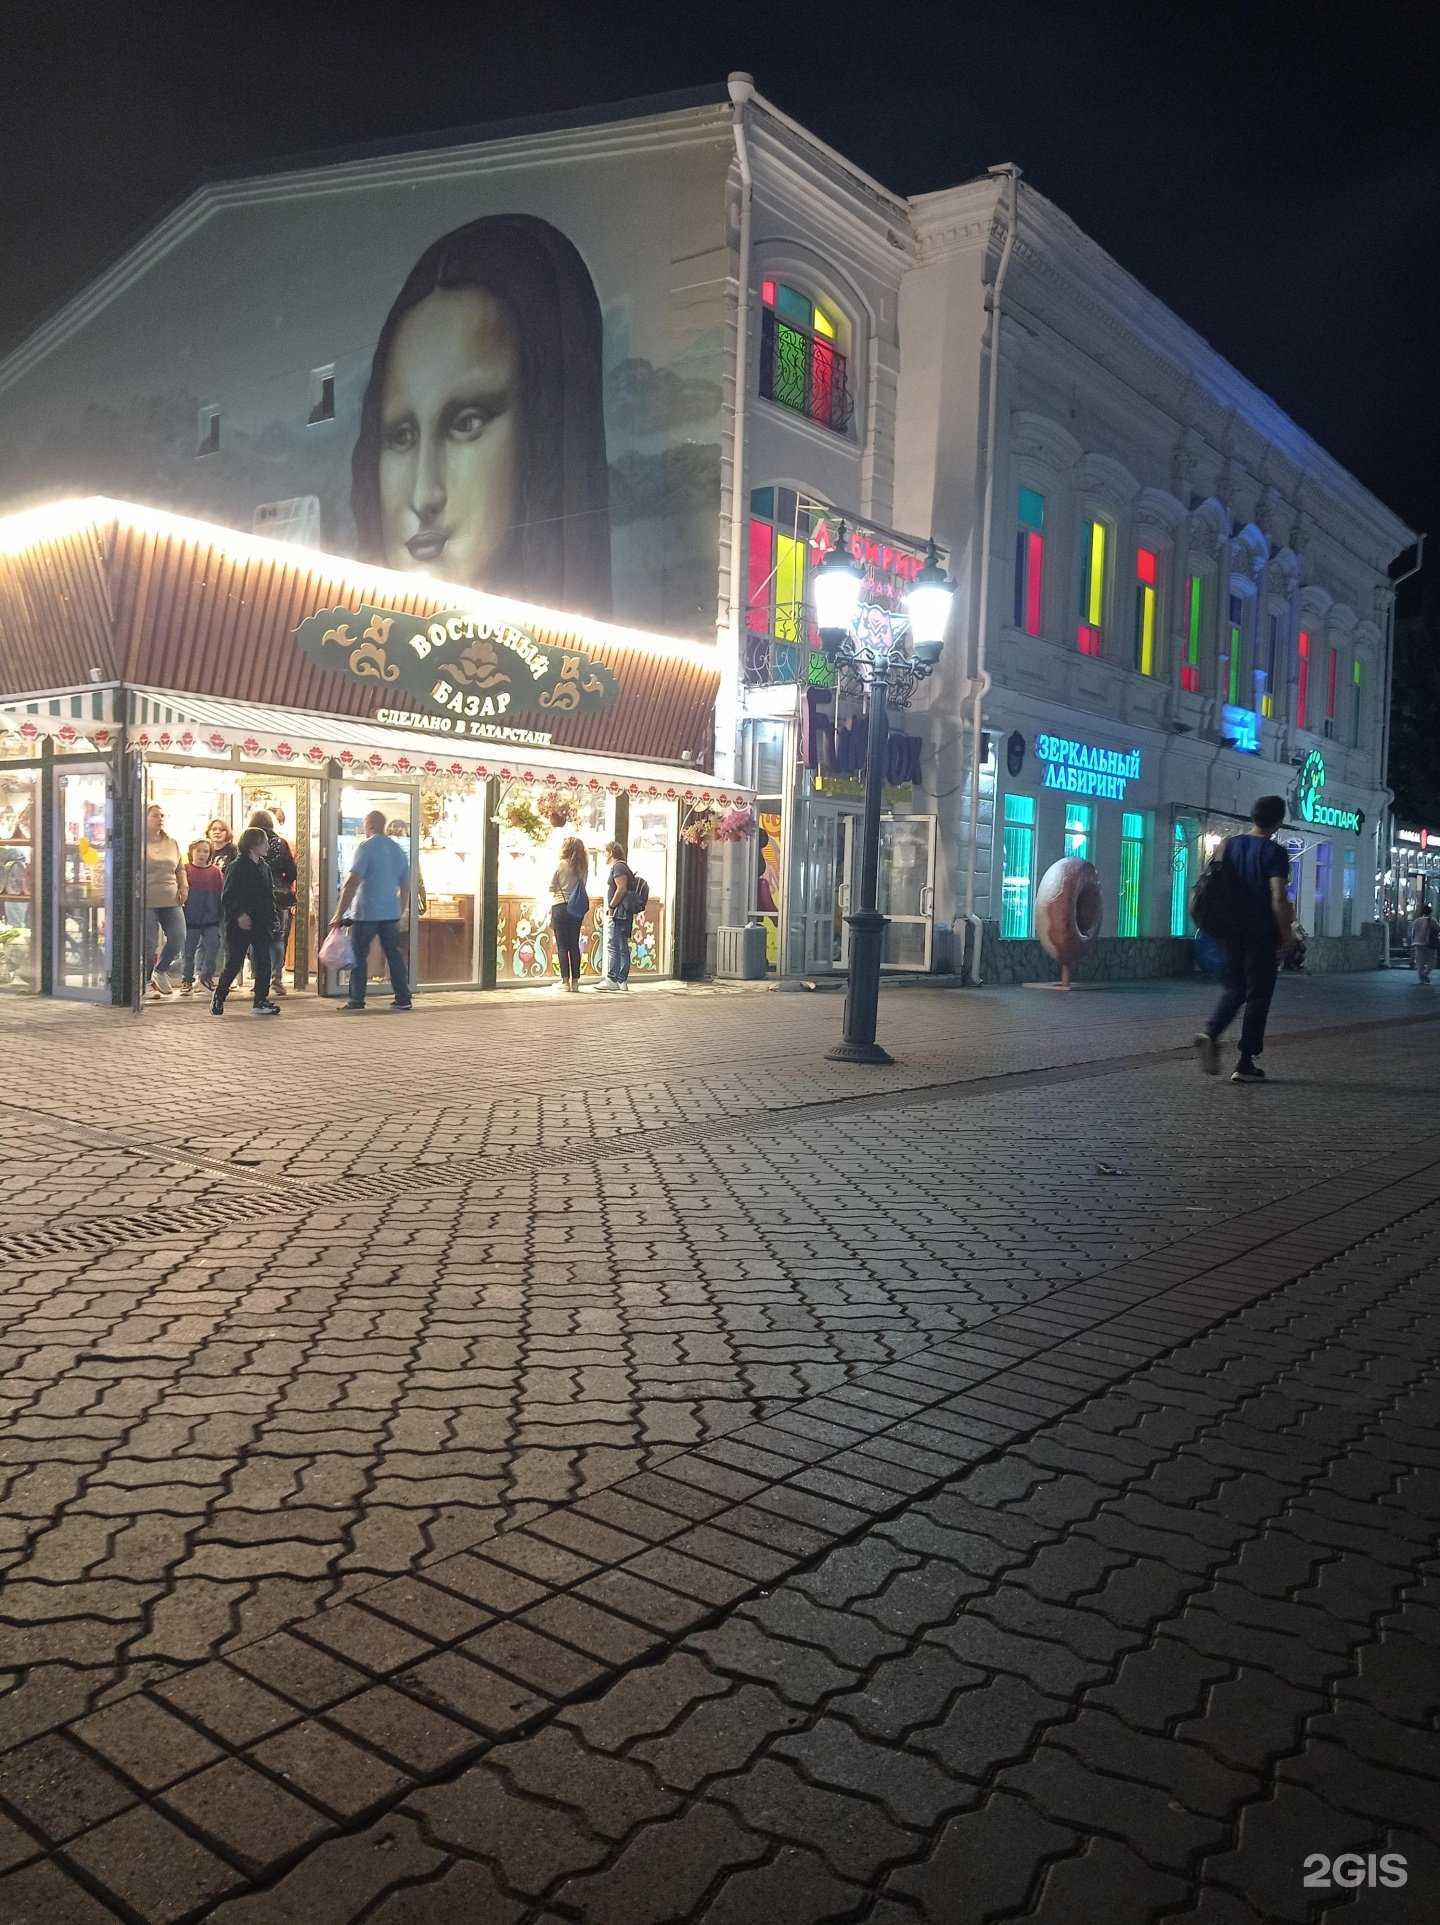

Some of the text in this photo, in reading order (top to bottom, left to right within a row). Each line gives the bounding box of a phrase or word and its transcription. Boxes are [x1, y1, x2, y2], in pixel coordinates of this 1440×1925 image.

[431, 680, 511, 717] БАЗАР
[376, 708, 553, 745] СДЕЛАНО В ТАТАРСТАНЕ
[1038, 733, 1140, 779] ЗЕРКАЛЬНЫЙ
[1044, 763, 1127, 801] ЛАБИРИНТ
[1313, 804, 1360, 832] ЗООПАРК
